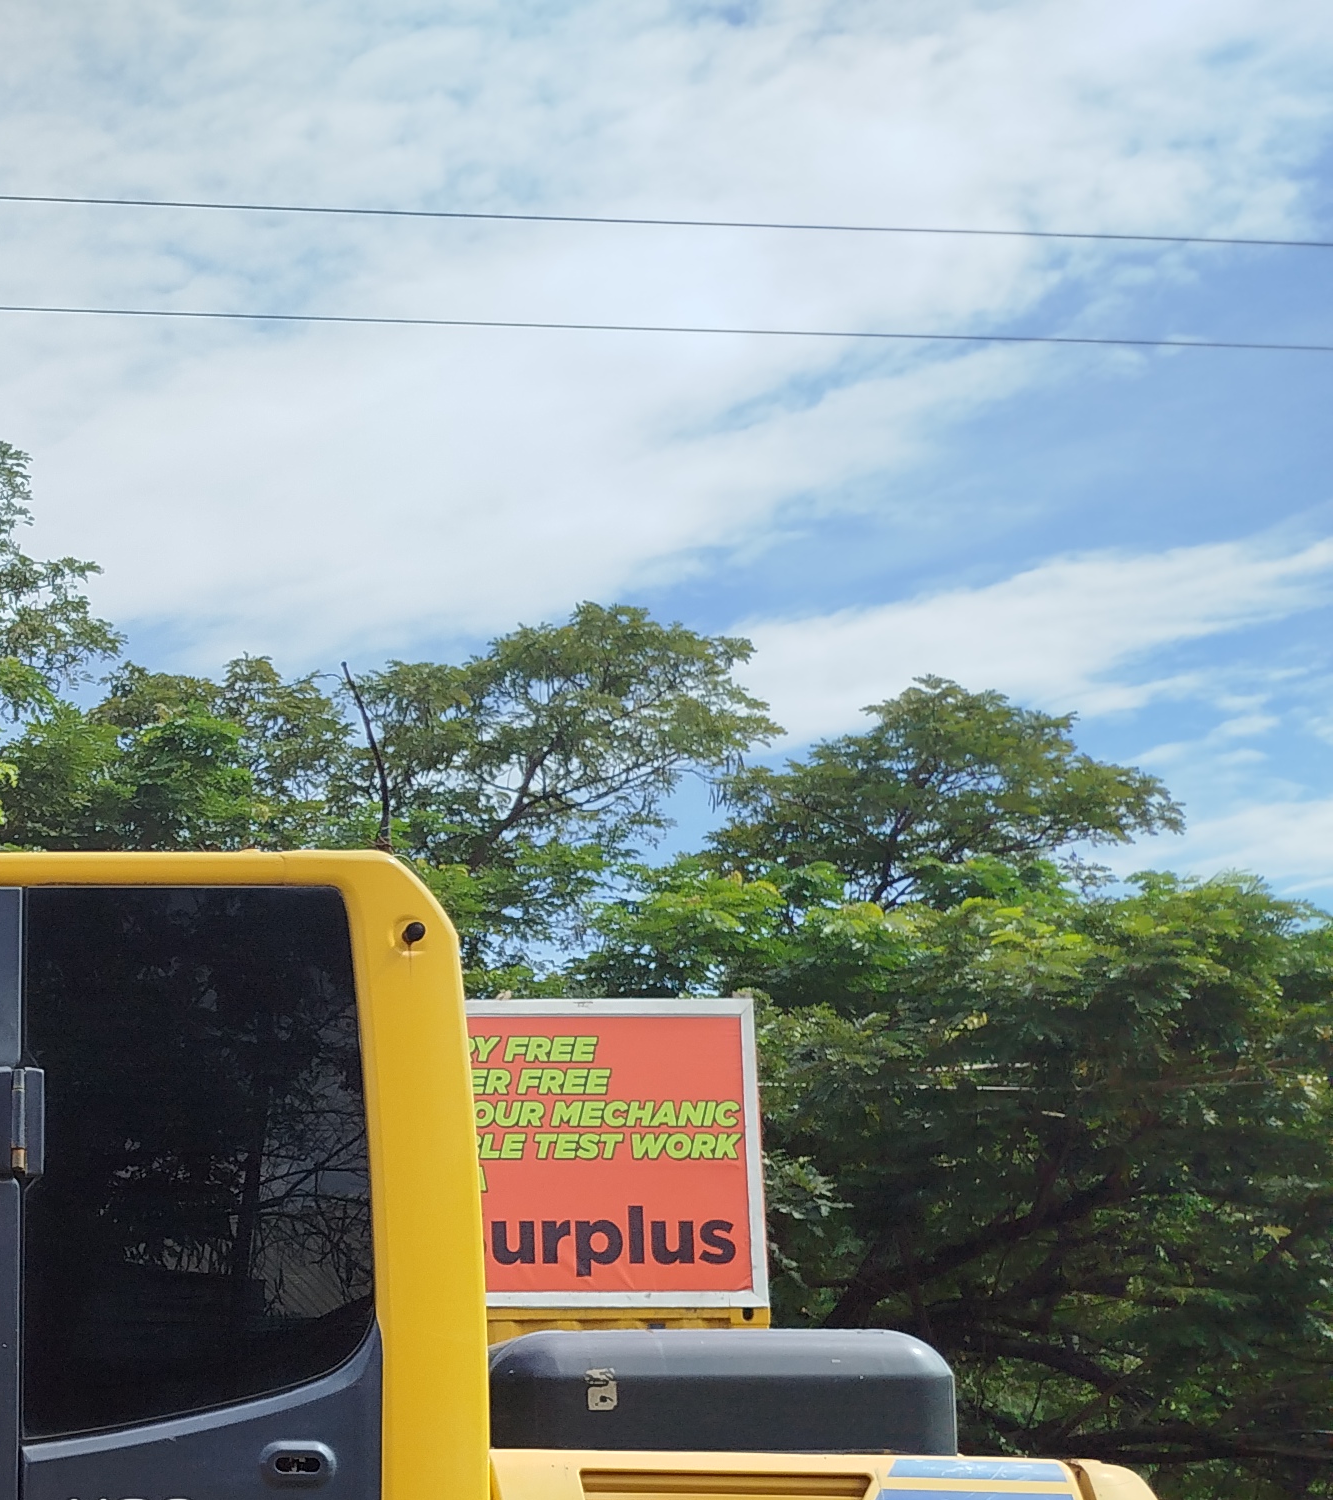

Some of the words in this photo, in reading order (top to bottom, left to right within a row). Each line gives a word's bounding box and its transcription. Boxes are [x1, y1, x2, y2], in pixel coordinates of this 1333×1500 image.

[503, 1035, 598, 1063] FREE
[517, 1068, 611, 1095] FREE
[474, 1100, 545, 1127] OUR
[549, 1100, 740, 1128] MECHANIC
[476, 1133, 526, 1160] LE
[533, 1133, 624, 1160] TEST
[631, 1133, 742, 1160] WORK
[489, 1204, 736, 1277] urplus
